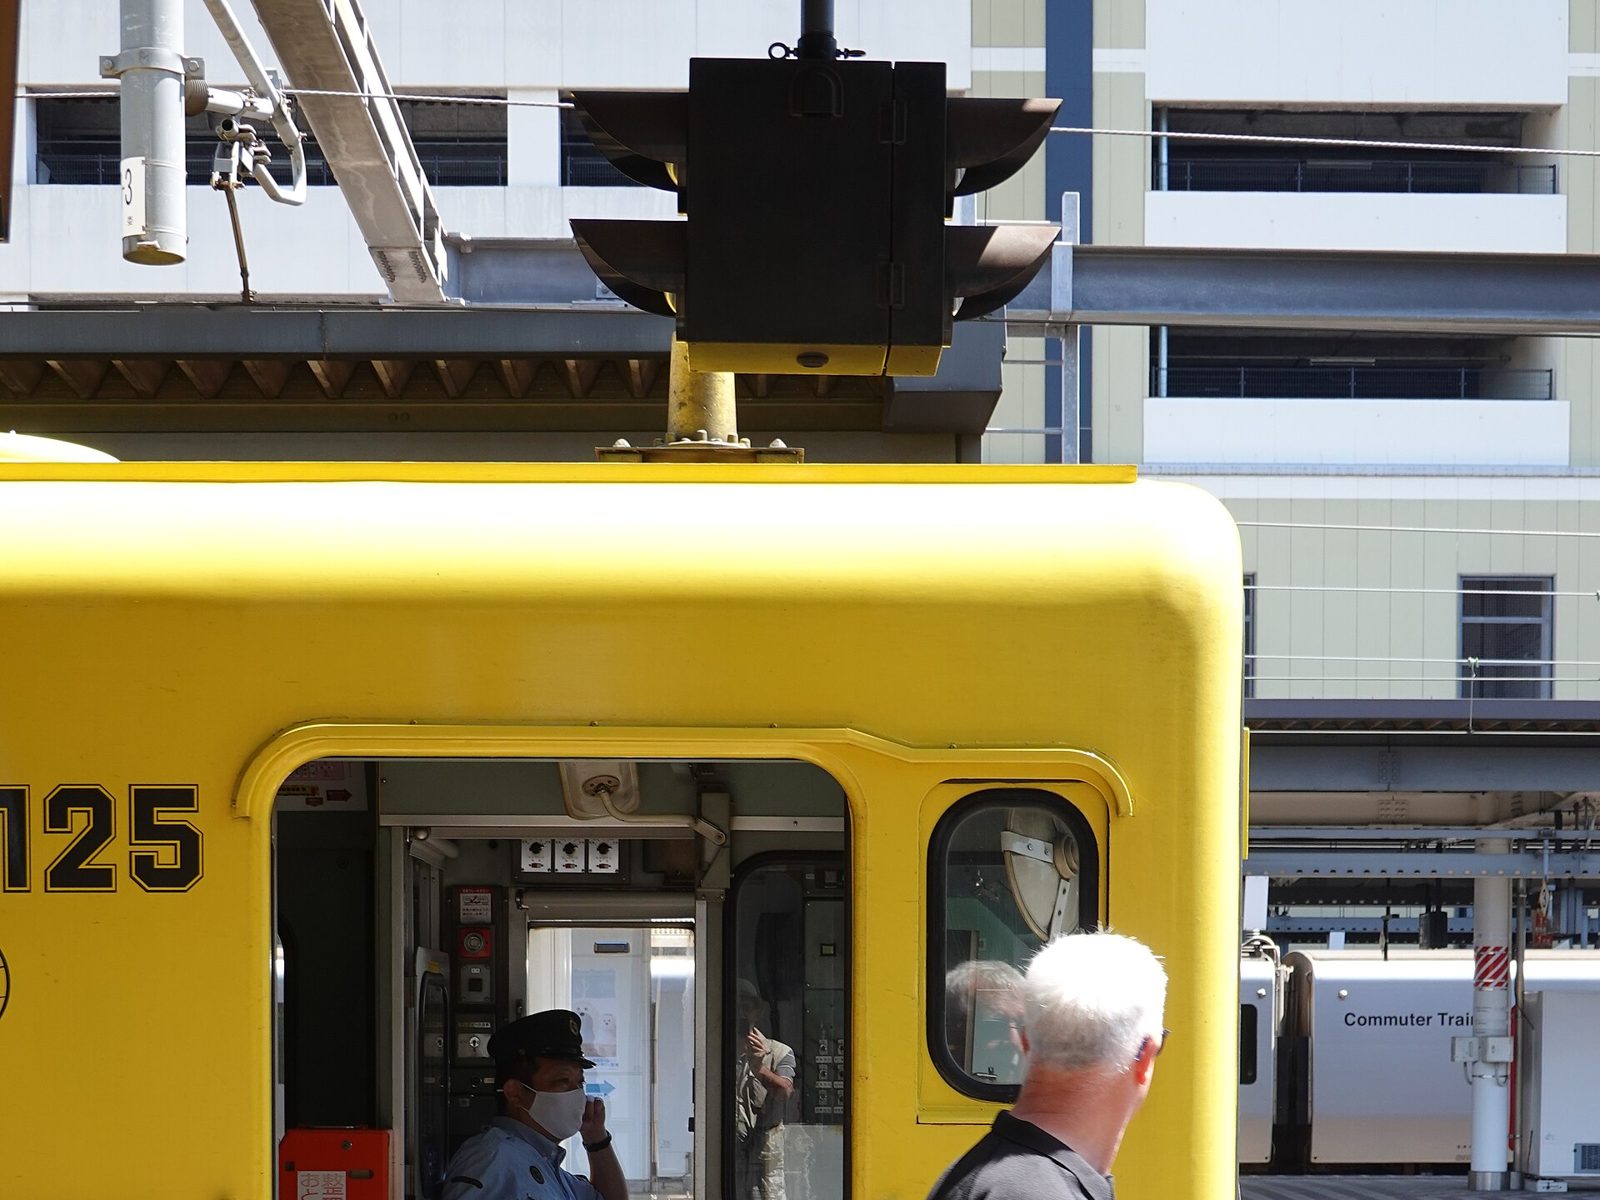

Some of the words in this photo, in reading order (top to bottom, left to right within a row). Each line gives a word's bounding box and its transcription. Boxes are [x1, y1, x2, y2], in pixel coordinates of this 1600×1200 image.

[0, 784, 204, 893] 125
[1344, 1012, 1433, 1027] Commuter
[1437, 1012, 1474, 1027] Trai
